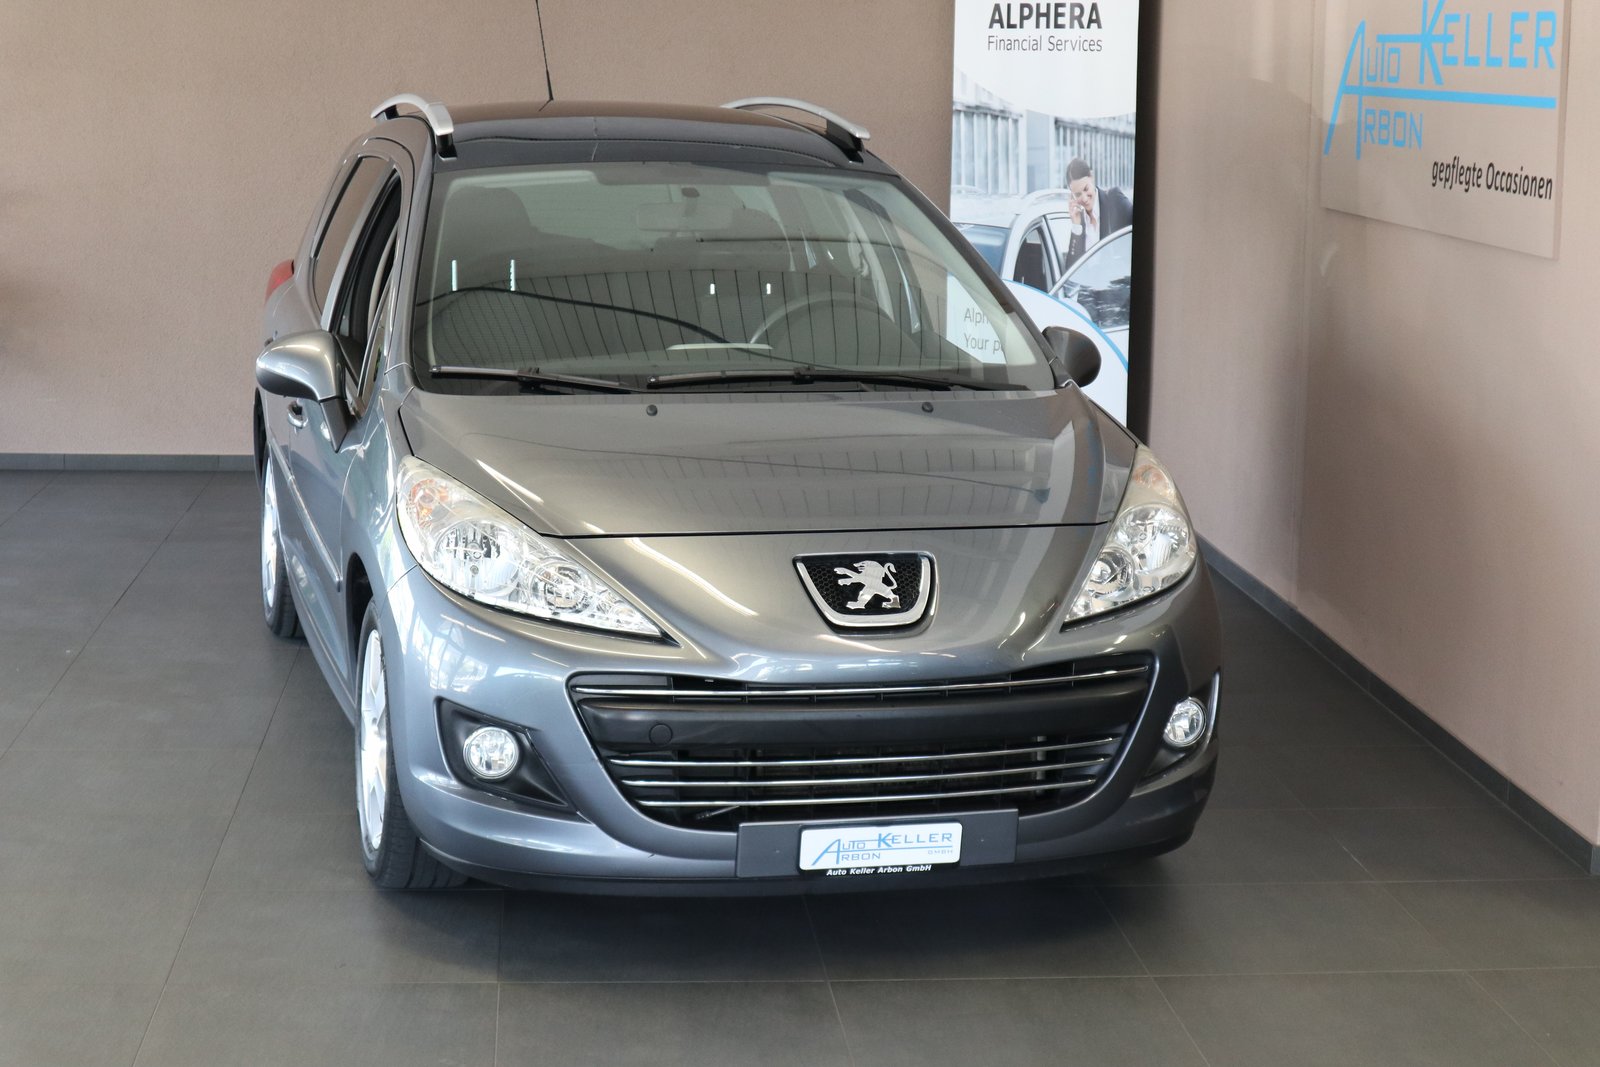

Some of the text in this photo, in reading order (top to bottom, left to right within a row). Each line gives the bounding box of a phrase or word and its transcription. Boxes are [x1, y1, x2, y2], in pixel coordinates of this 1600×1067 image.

[988, 2, 1103, 29] ALPHERA
[987, 35, 1103, 52] Financial Services
[1418, 0, 1557, 85] KELLER
[1431, 155, 1553, 200] gepflegte Occasionen
[964, 333, 989, 350] Your
[877, 832, 953, 848] KELLER
[826, 864, 932, 876] Auto Keller Arbon GmbH
